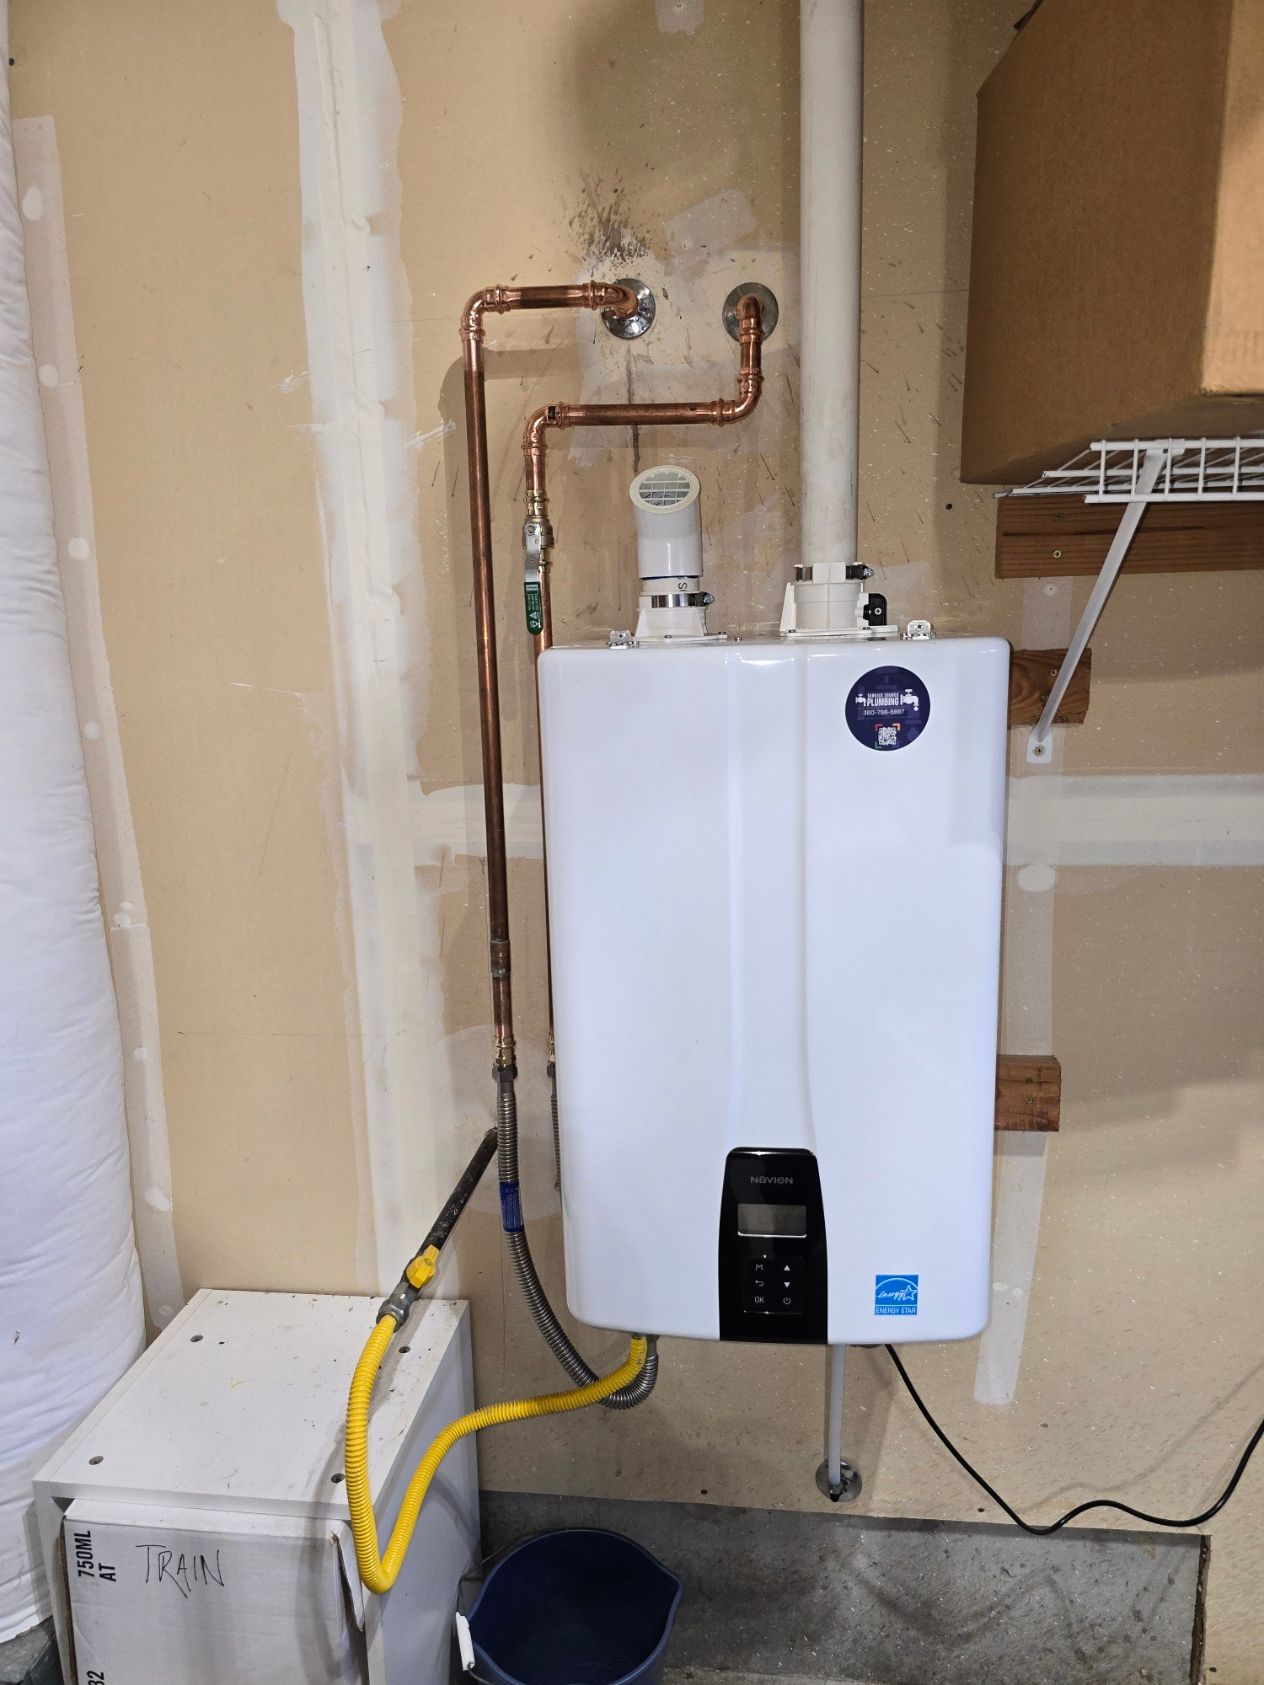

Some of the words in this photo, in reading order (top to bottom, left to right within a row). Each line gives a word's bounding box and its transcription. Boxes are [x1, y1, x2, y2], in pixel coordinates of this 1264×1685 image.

[867, 697, 899, 706] PLUMBING
[876, 1306, 899, 1314] ENERGY
[900, 1306, 915, 1314] STAR
[74, 1530, 95, 1578] 750ML
[98, 1562, 117, 1583] AT
[135, 1544, 225, 1599] TRAIN
